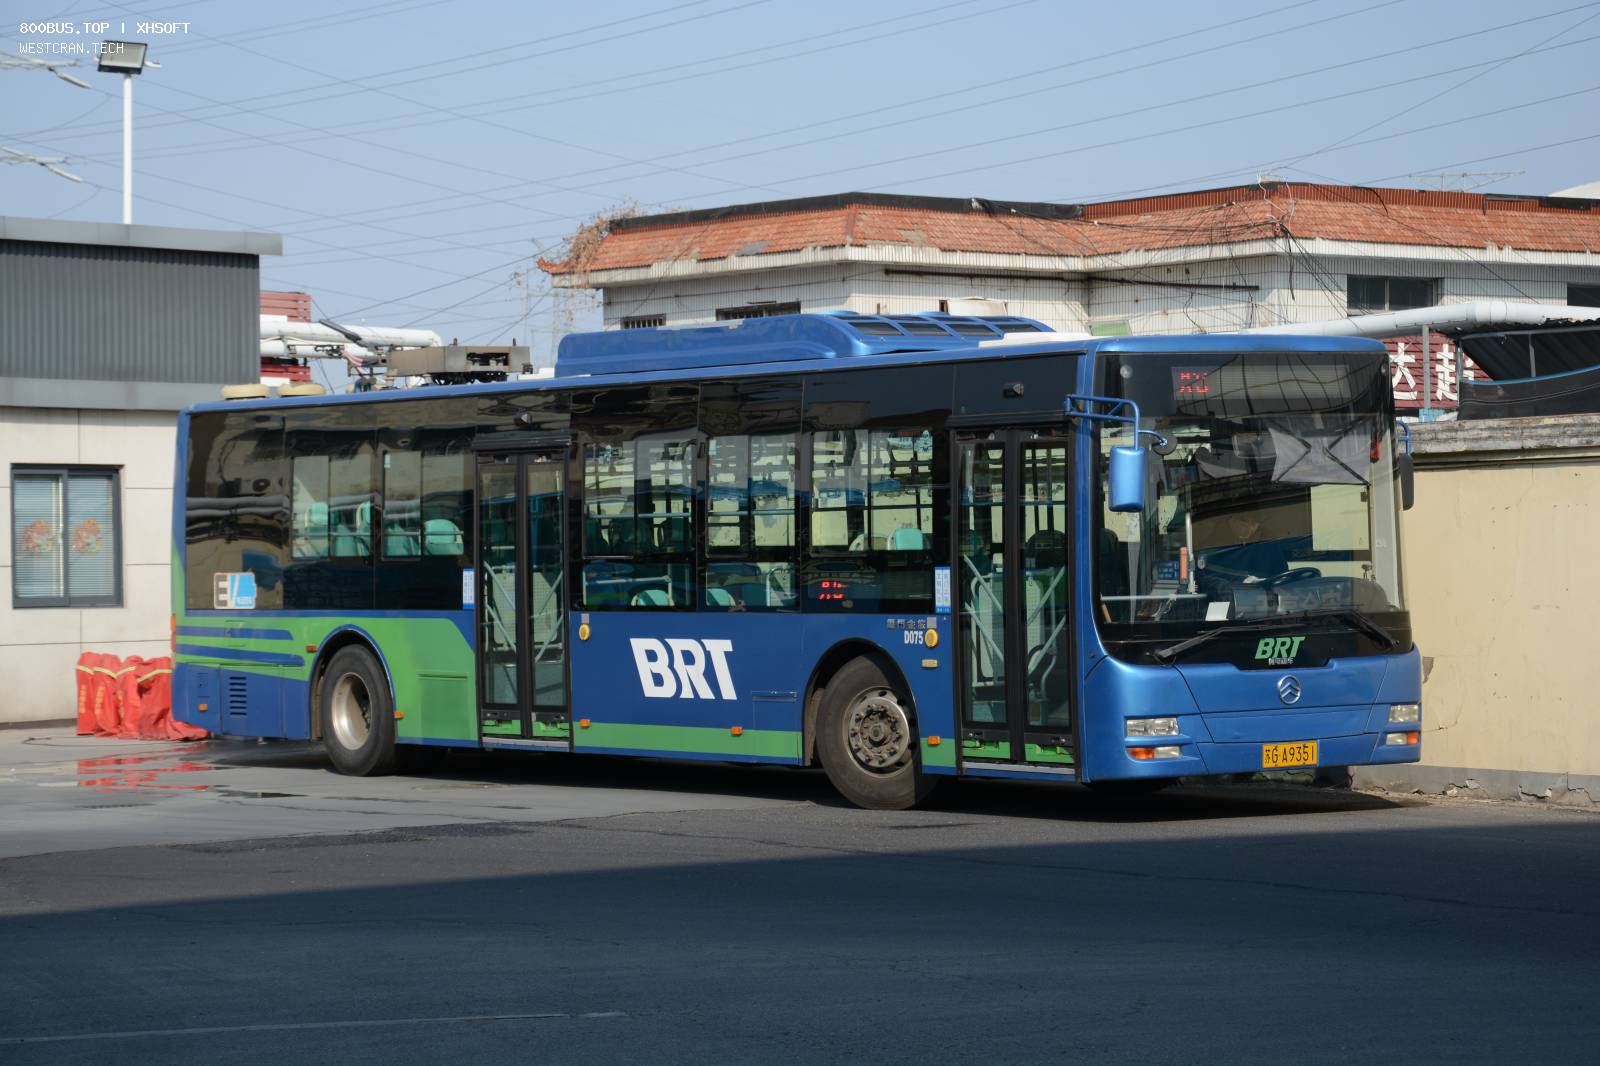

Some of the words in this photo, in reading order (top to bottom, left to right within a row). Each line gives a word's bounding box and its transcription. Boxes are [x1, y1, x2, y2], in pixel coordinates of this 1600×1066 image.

[903, 630, 924, 644] D075
[1254, 636, 1307, 659] BRT
[629, 637, 738, 700] BRT
